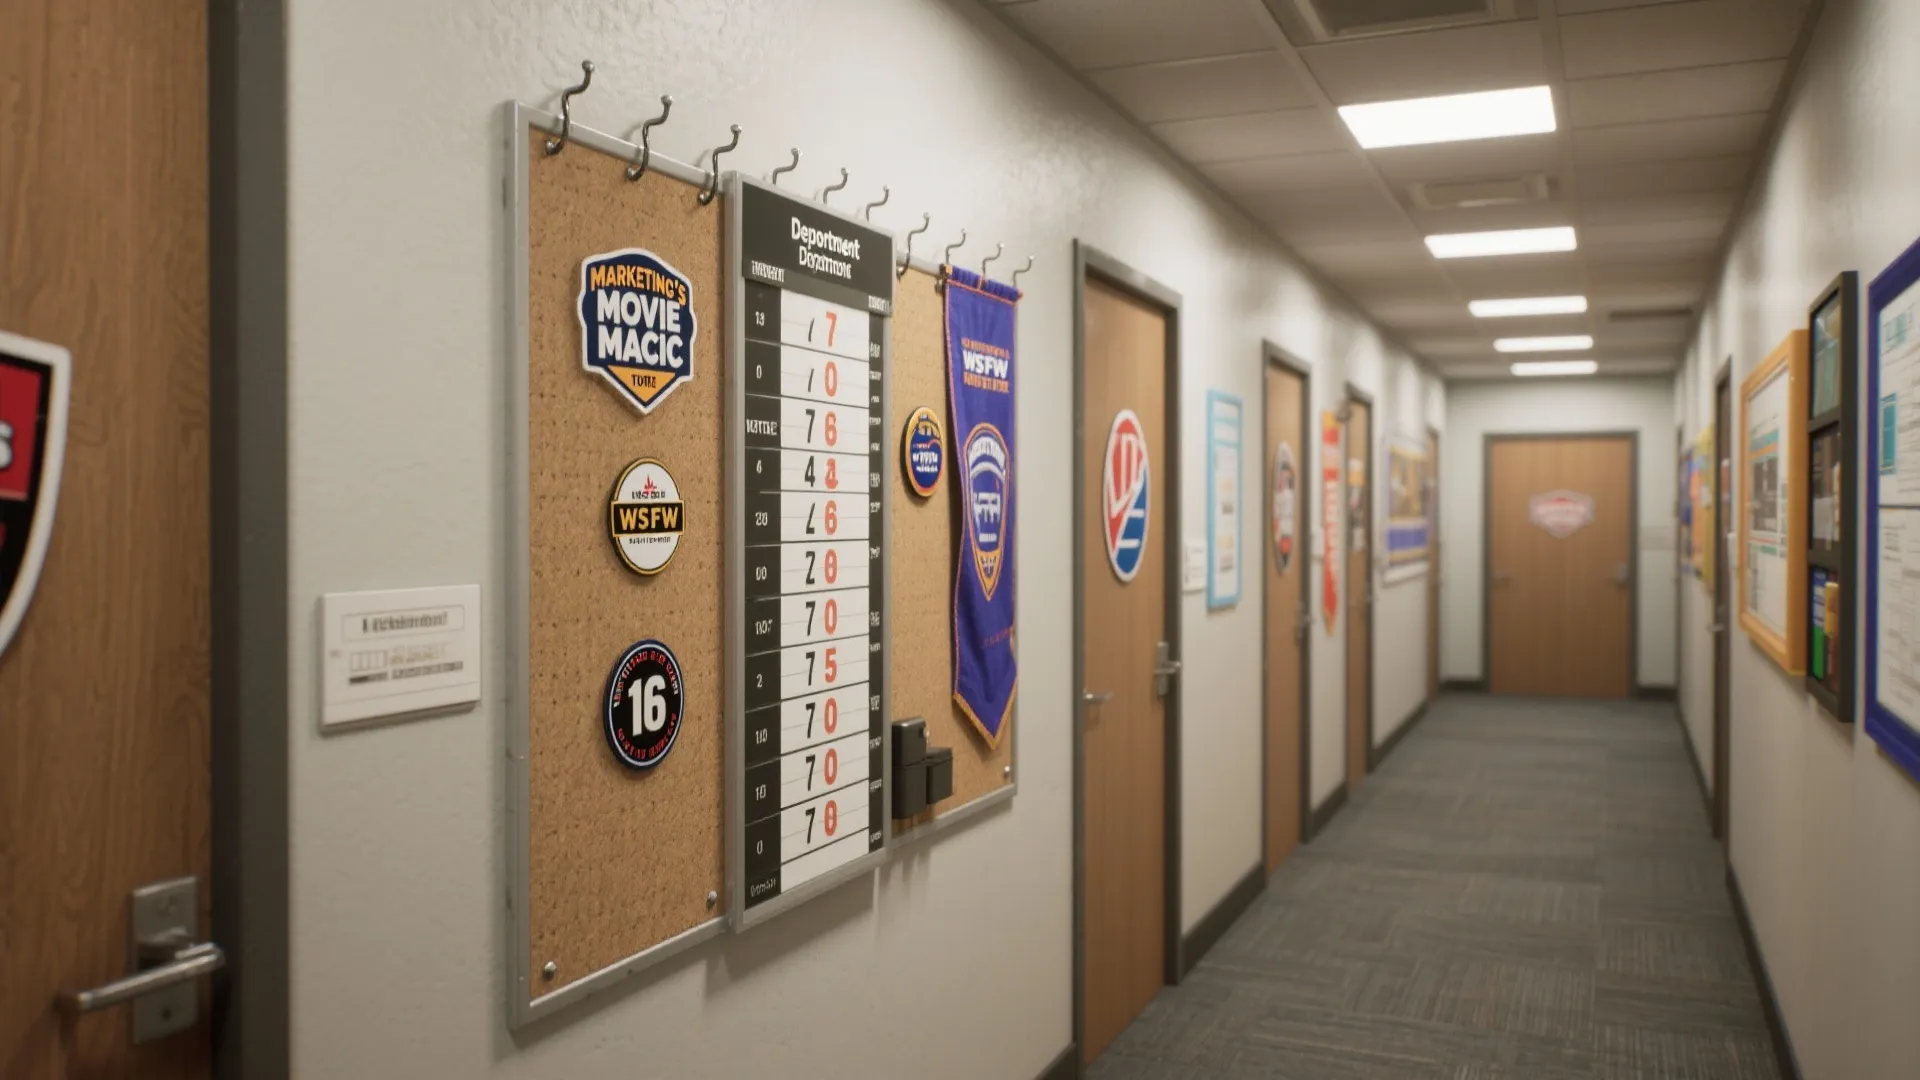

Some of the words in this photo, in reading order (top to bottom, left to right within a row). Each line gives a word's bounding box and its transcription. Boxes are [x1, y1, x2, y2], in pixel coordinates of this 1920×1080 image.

[590, 265, 687, 306] MARKETING'S
[597, 289, 681, 333] MOVIE
[826, 310, 837, 347] 7
[825, 361, 838, 397] 0
[962, 350, 1009, 379] WSFW
[805, 408, 816, 443] 7
[825, 411, 838, 446] 6
[804, 455, 816, 487] 4
[619, 507, 678, 530] WSFW
[824, 500, 838, 535] 6
[805, 550, 816, 585] 2
[805, 600, 816, 636] 7
[824, 599, 838, 634] 0
[805, 651, 816, 687] 7
[824, 648, 838, 683] 5
[628, 674, 667, 737] 16
[805, 702, 816, 739] 7
[824, 697, 838, 734] 0
[805, 754, 816, 792] 7
[824, 748, 838, 785] 0
[805, 807, 816, 844] 7
